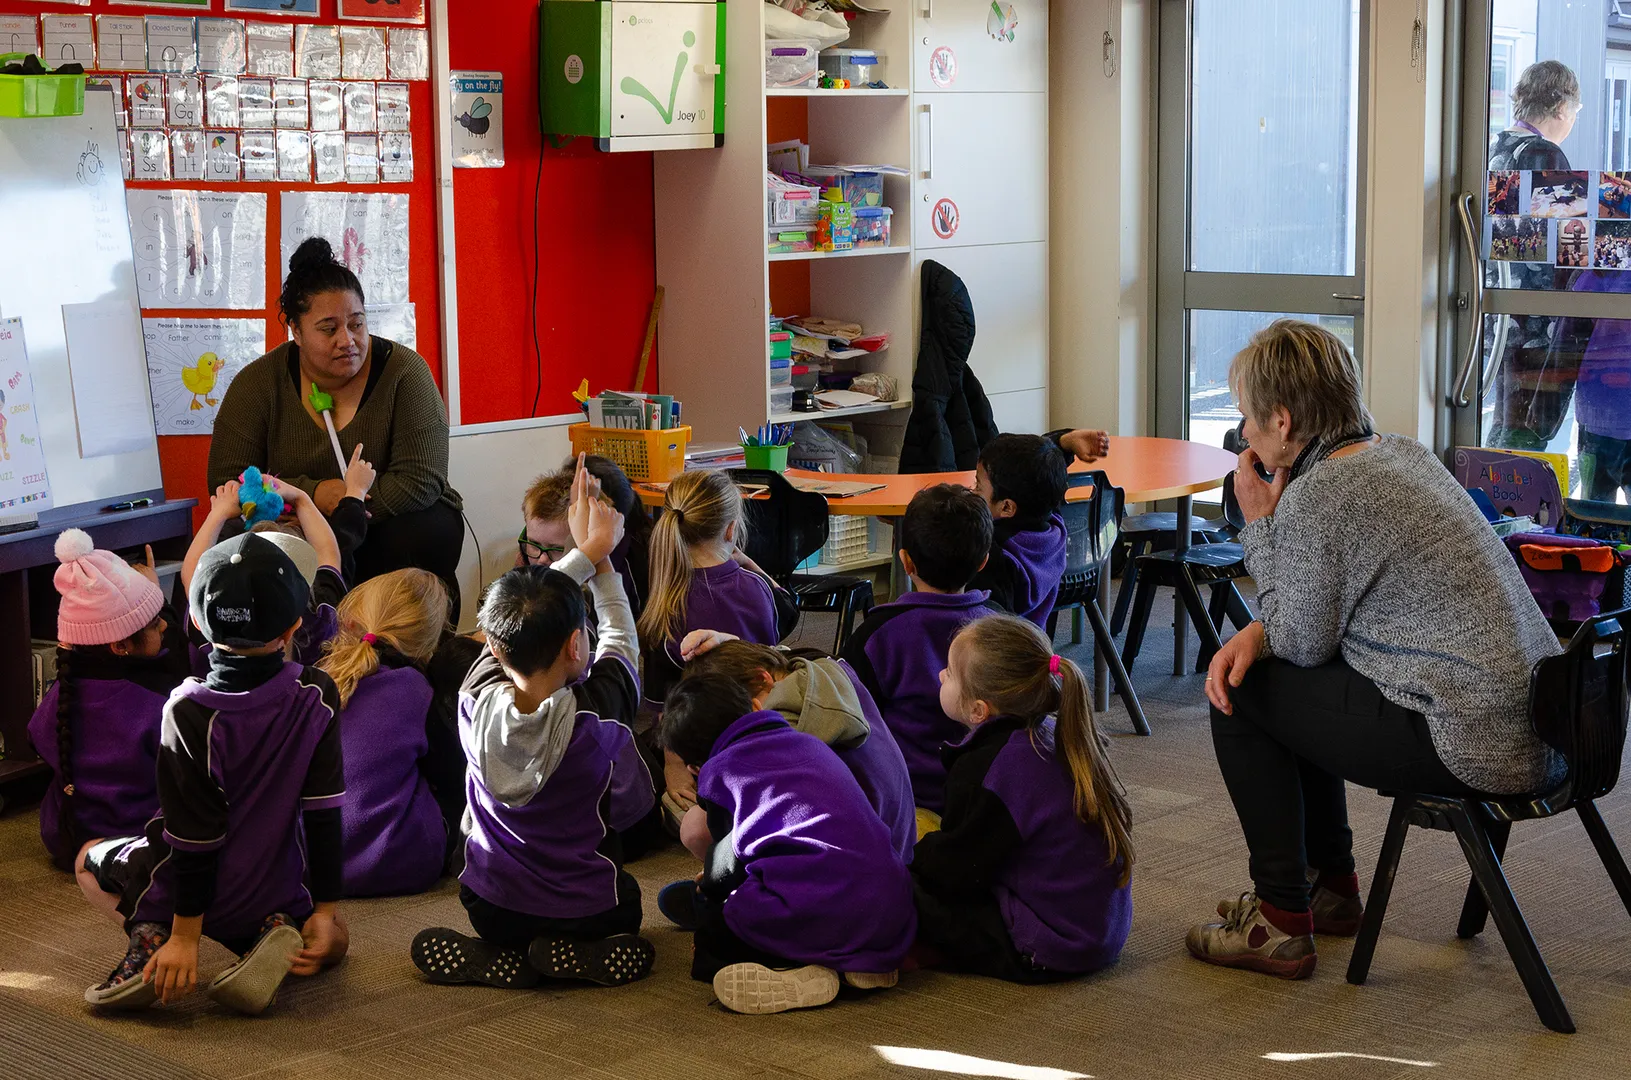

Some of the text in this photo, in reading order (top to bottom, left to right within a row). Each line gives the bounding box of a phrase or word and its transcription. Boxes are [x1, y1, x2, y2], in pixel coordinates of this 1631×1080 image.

[476, 81, 487, 89] the
[489, 81, 501, 93] fly!
[174, 103, 194, 127] Gg
[677, 109, 706, 122] Joey 10
[142, 156, 157, 172] Ss
[153, 213, 158, 221] it
[145, 243, 154, 251] in
[22, 472, 46, 486] SIZZLE
[1480, 465, 1533, 486] Alphabet
[1492, 486, 1523, 502] Book
